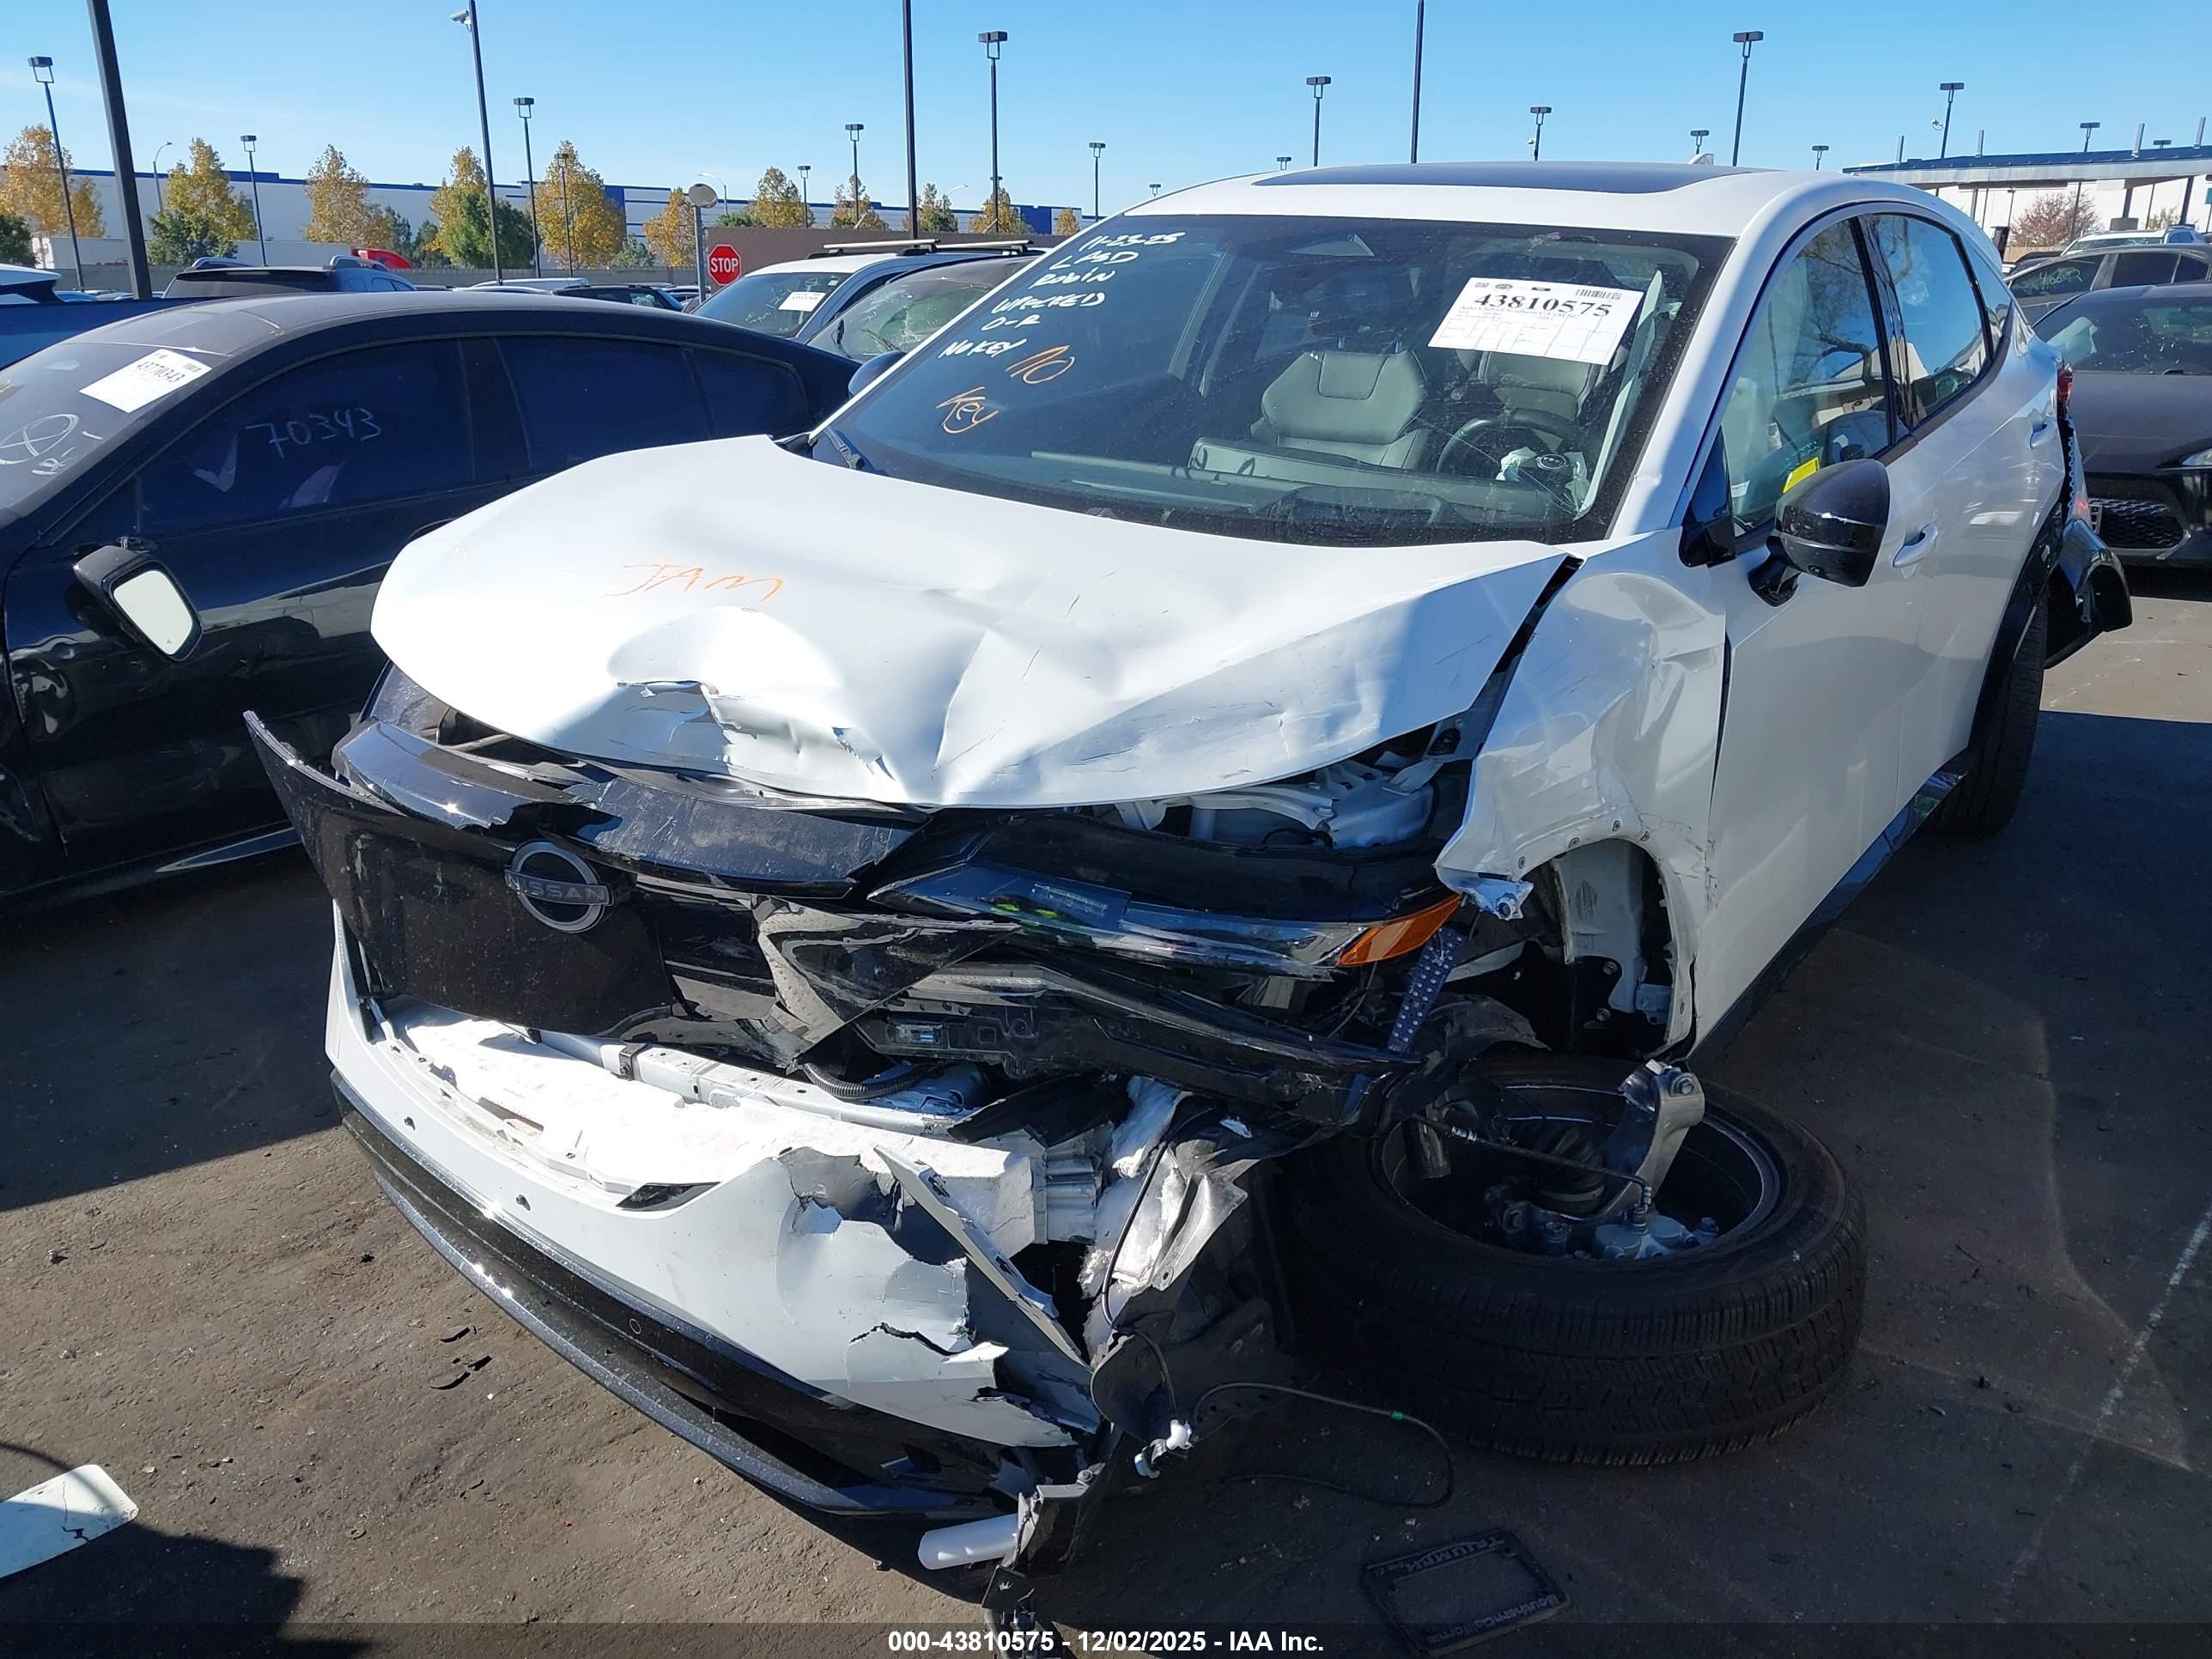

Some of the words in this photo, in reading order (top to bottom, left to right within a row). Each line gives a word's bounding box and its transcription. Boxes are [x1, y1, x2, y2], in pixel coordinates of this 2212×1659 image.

[710, 257, 738, 273] STOP
[1474, 294, 1613, 317] 43810575
[967, 338, 1028, 358] KEY
[246, 406, 381, 459] 70343
[507, 873, 606, 902] NISSAN
